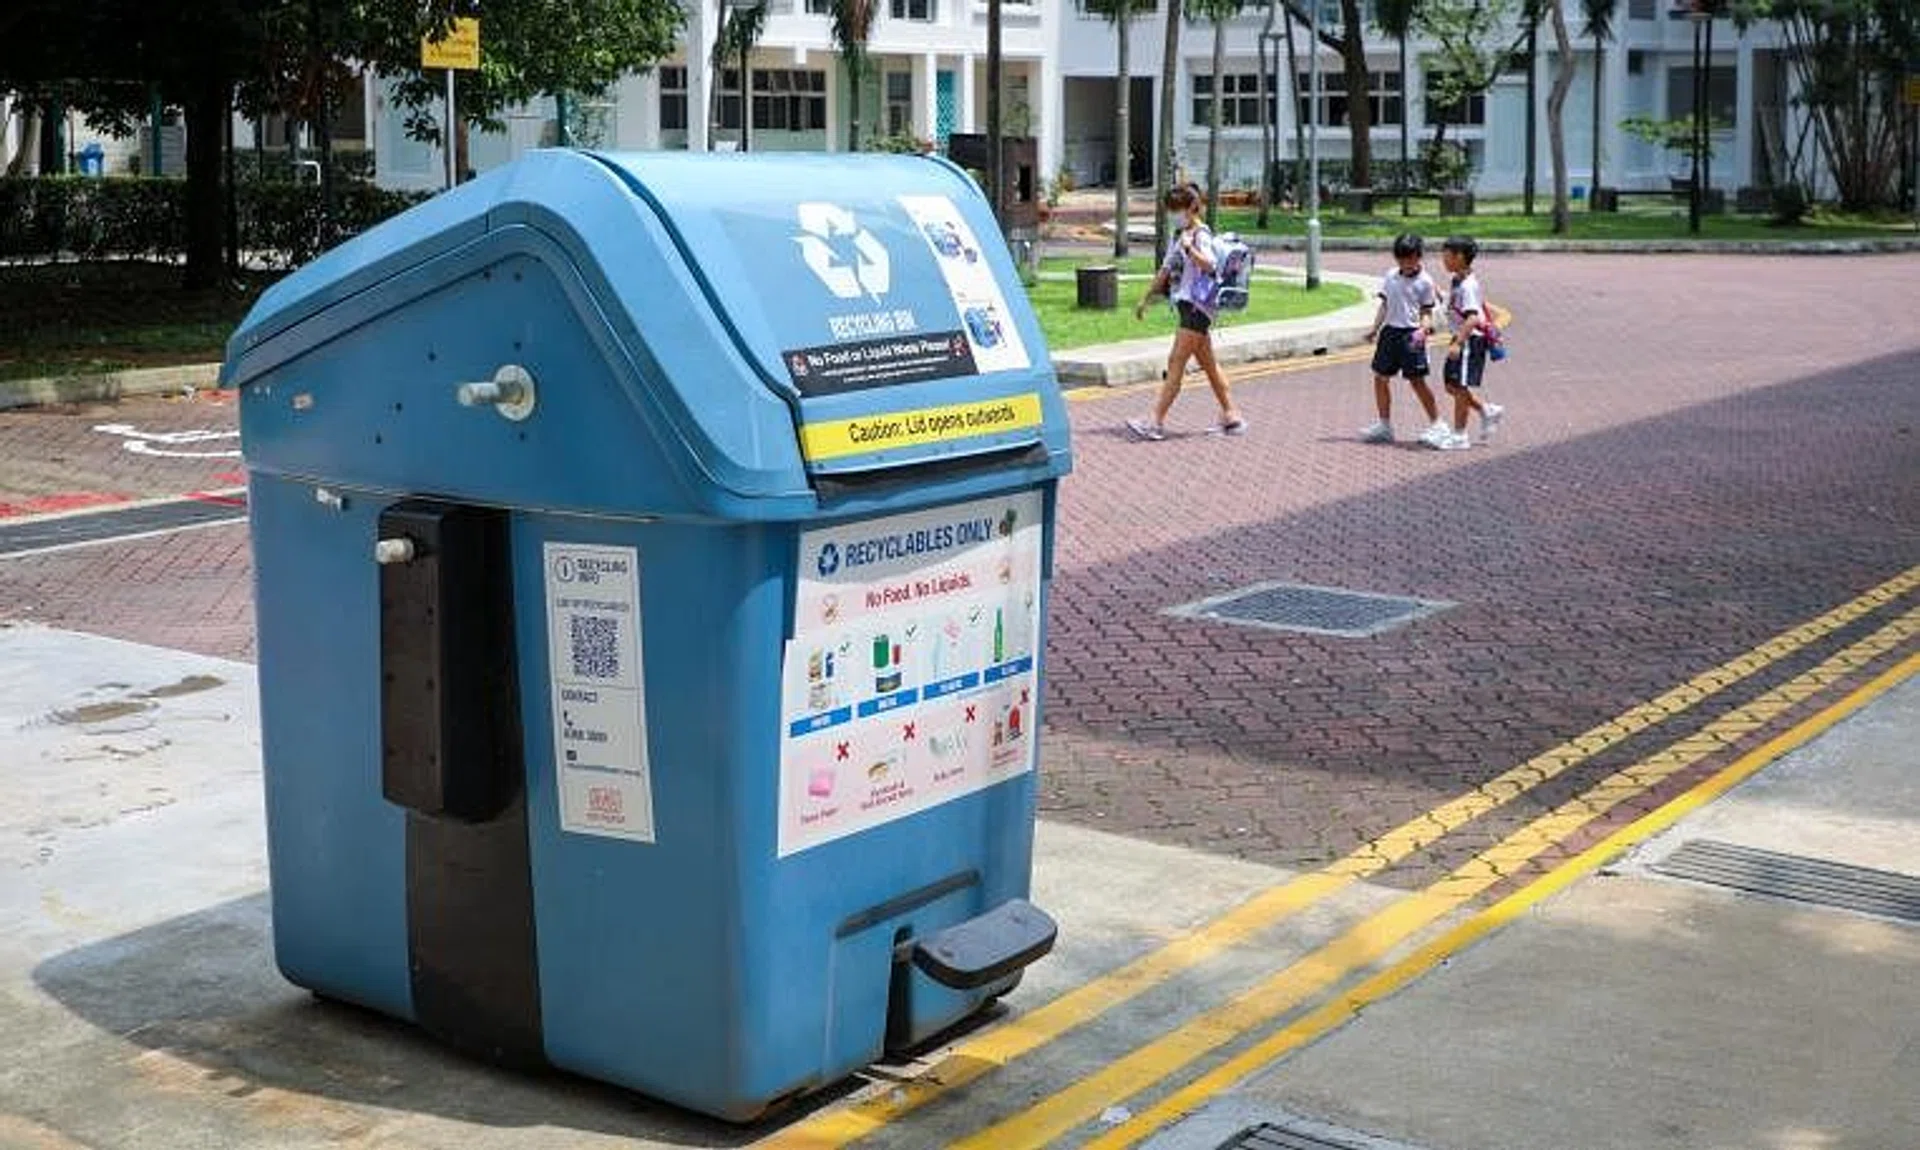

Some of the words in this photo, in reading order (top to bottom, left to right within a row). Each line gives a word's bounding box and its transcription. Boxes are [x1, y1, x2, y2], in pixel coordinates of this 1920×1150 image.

[829, 313, 894, 340] RECYCLING
[807, 354, 824, 367] No
[823, 349, 850, 364] Food
[861, 344, 889, 359] Liquid
[848, 418, 905, 443] Caution:
[906, 412, 927, 434] Lid
[928, 412, 965, 436] opens
[966, 403, 1016, 427] outwards
[845, 527, 953, 568] RECYCLABLES
[957, 517, 993, 545] ONLY
[866, 591, 881, 608] No
[915, 581, 930, 598] No
